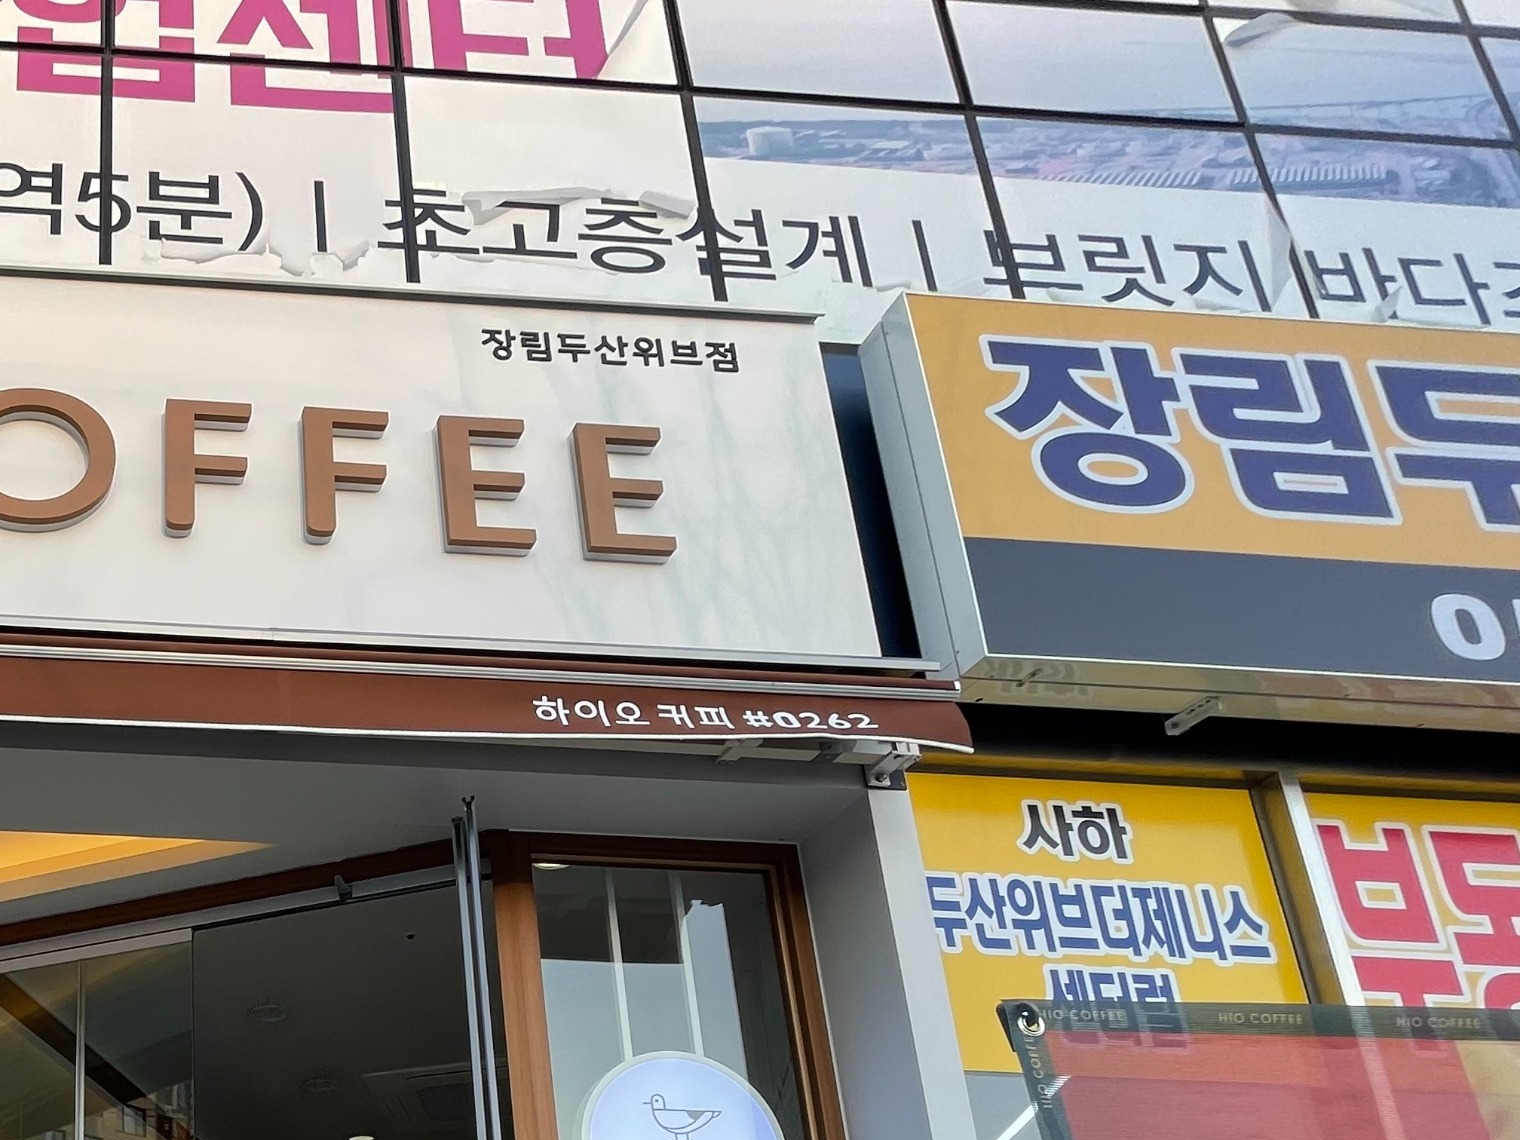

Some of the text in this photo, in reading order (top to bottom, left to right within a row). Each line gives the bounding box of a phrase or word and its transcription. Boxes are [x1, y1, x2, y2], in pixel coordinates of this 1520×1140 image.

[377, 188, 875, 288] 초고층설계
[982, 229, 1273, 312] 브릿지
[480, 328, 741, 373] 장림두산위브점
[532, 695, 880, 730] 하이오 커피 #0262
[1022, 801, 1132, 862] 사하
[925, 873, 1276, 963] 두산위브더제니스
[1218, 1012, 1304, 1025] HIO COFFEE
